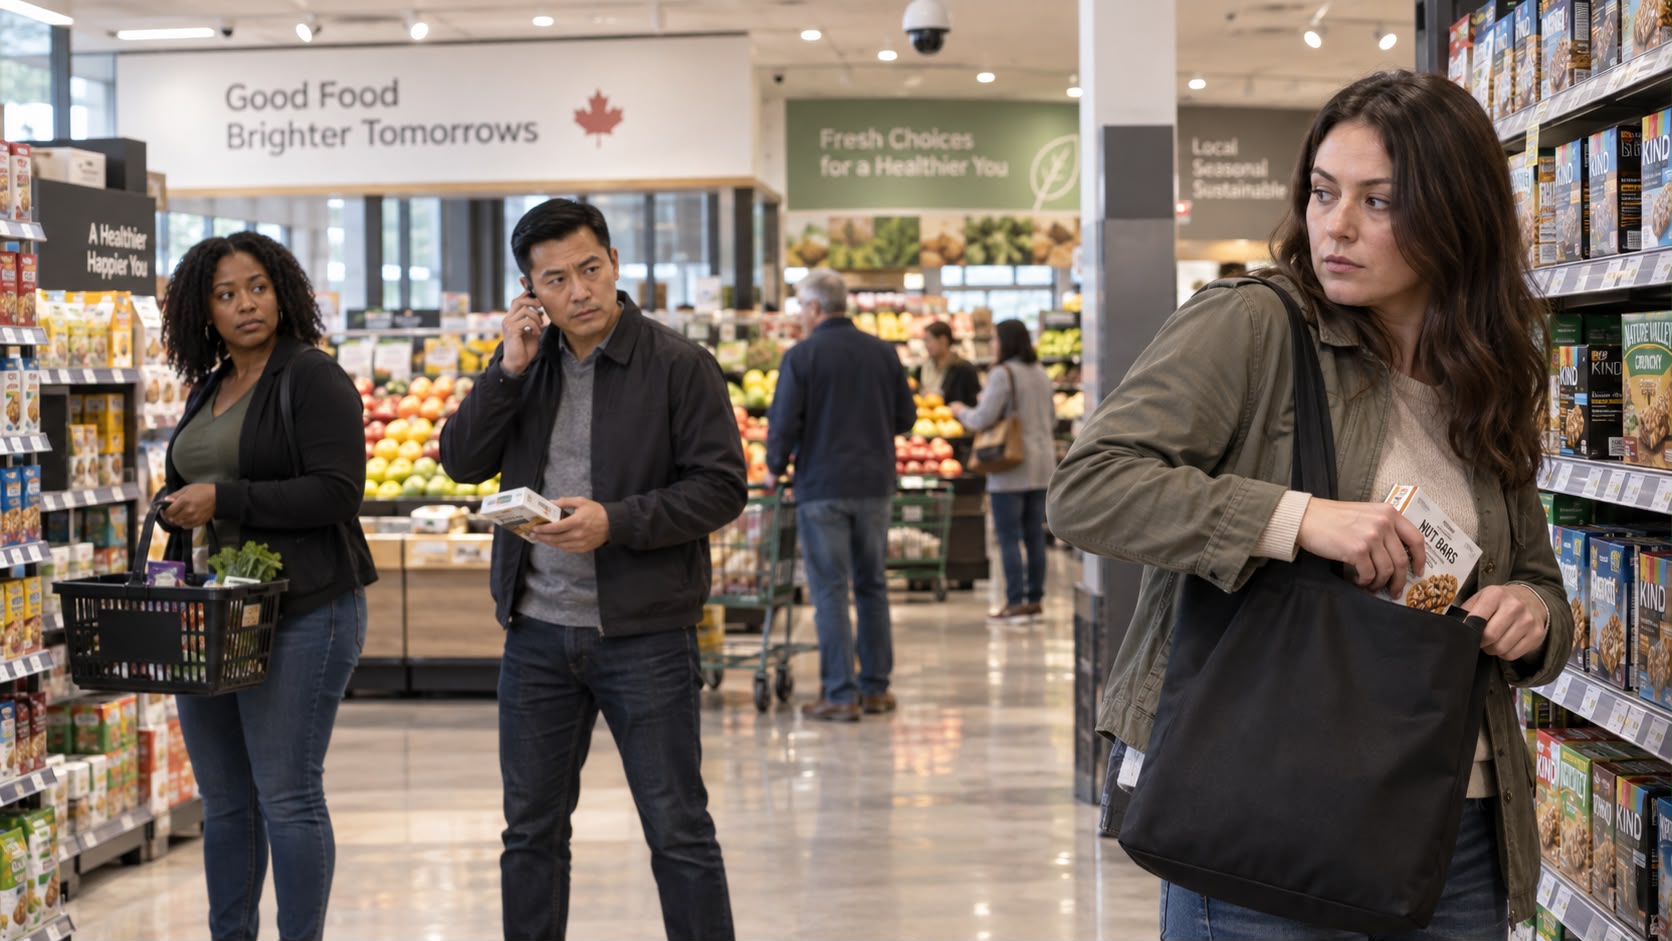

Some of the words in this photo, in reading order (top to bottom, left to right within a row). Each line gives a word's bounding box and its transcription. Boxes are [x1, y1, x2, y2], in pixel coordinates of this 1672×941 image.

[226, 81, 308, 110] Good
[320, 78, 399, 108] Food
[228, 121, 351, 155] Brighter
[363, 119, 538, 145] Tomorrows
[820, 128, 884, 150] Fresh
[889, 127, 973, 151] Choices
[1192, 137, 1239, 156] Local
[1641, 134, 1670, 166] KIND
[820, 155, 852, 178] for
[856, 160, 870, 178] a
[875, 156, 967, 178] Healthier
[972, 156, 1009, 178] You
[1192, 158, 1268, 178] Seasonal
[1556, 162, 1573, 187] KIND
[1590, 151, 1609, 178] KIND
[1192, 179, 1287, 199] Sustainable
[88, 222, 98, 245] A
[100, 223, 147, 250] Healthier
[87, 250, 128, 280] Happier
[129, 254, 148, 278] You
[1624, 322, 1649, 351] NATURE
[1559, 366, 1578, 386] KIND
[1592, 361, 1622, 376] KIND
[1419, 519, 1439, 542] NUT
[1435, 537, 1459, 565] BARS
[1640, 581, 1666, 613] KIND
[1616, 803, 1642, 841] KIND
